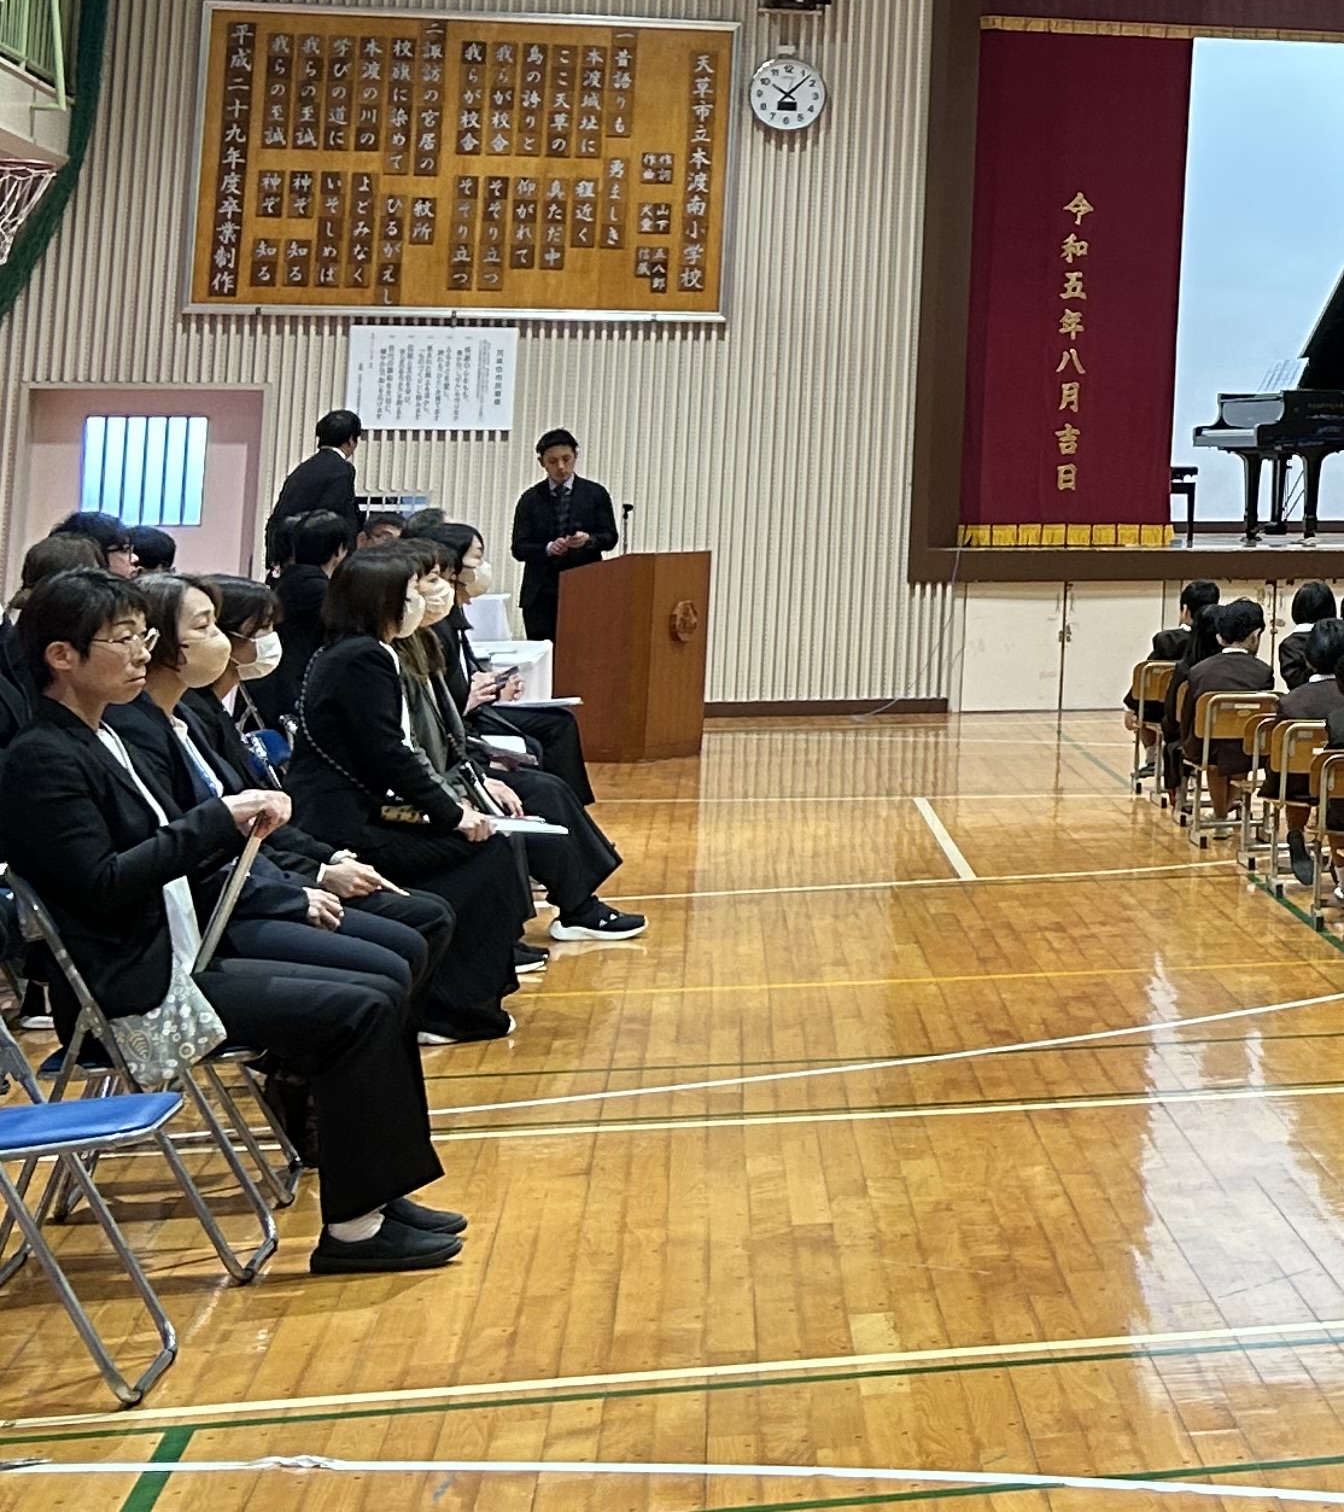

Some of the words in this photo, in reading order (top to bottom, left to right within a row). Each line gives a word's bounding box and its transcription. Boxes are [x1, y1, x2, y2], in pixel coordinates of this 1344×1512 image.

[264, 35, 289, 146] 我らの至誠
[296, 36, 320, 146] 我らの至誠
[327, 38, 352, 145] 学びの道に
[360, 38, 383, 145] 本渡の川の
[389, 39, 414, 169] 校旗に染めて
[550, 50, 571, 151] ここ天草の
[579, 49, 603, 152] 本渡城址に
[770, 111, 777, 121] 7
[783, 64, 795, 74] 12
[807, 104, 814, 113] 4
[808, 79, 817, 88] 2
[211, 24, 254, 294] 平成二十九年度卒業制作
[782, 116, 790, 125] 6
[412, 201, 434, 240] 紋所
[515, 179, 536, 264] 仰がれて
[544, 180, 565, 266] 真ただ中
[575, 180, 595, 242] 程近く
[606, 159, 625, 245] 勇ましき
[655, 204, 670, 232] 山下
[681, 55, 715, 289] 天草市立本渡南小学校
[255, 241, 277, 281] 知る
[286, 241, 308, 281] 知る
[319, 177, 343, 281] いそしめば
[353, 175, 372, 283] よどみなく
[382, 198, 403, 305] ひるがえし
[452, 178, 473, 282] そそり立つ
[482, 179, 503, 283] そそり立つ
[1055, 191, 1095, 491] 令和五年八月吉日
